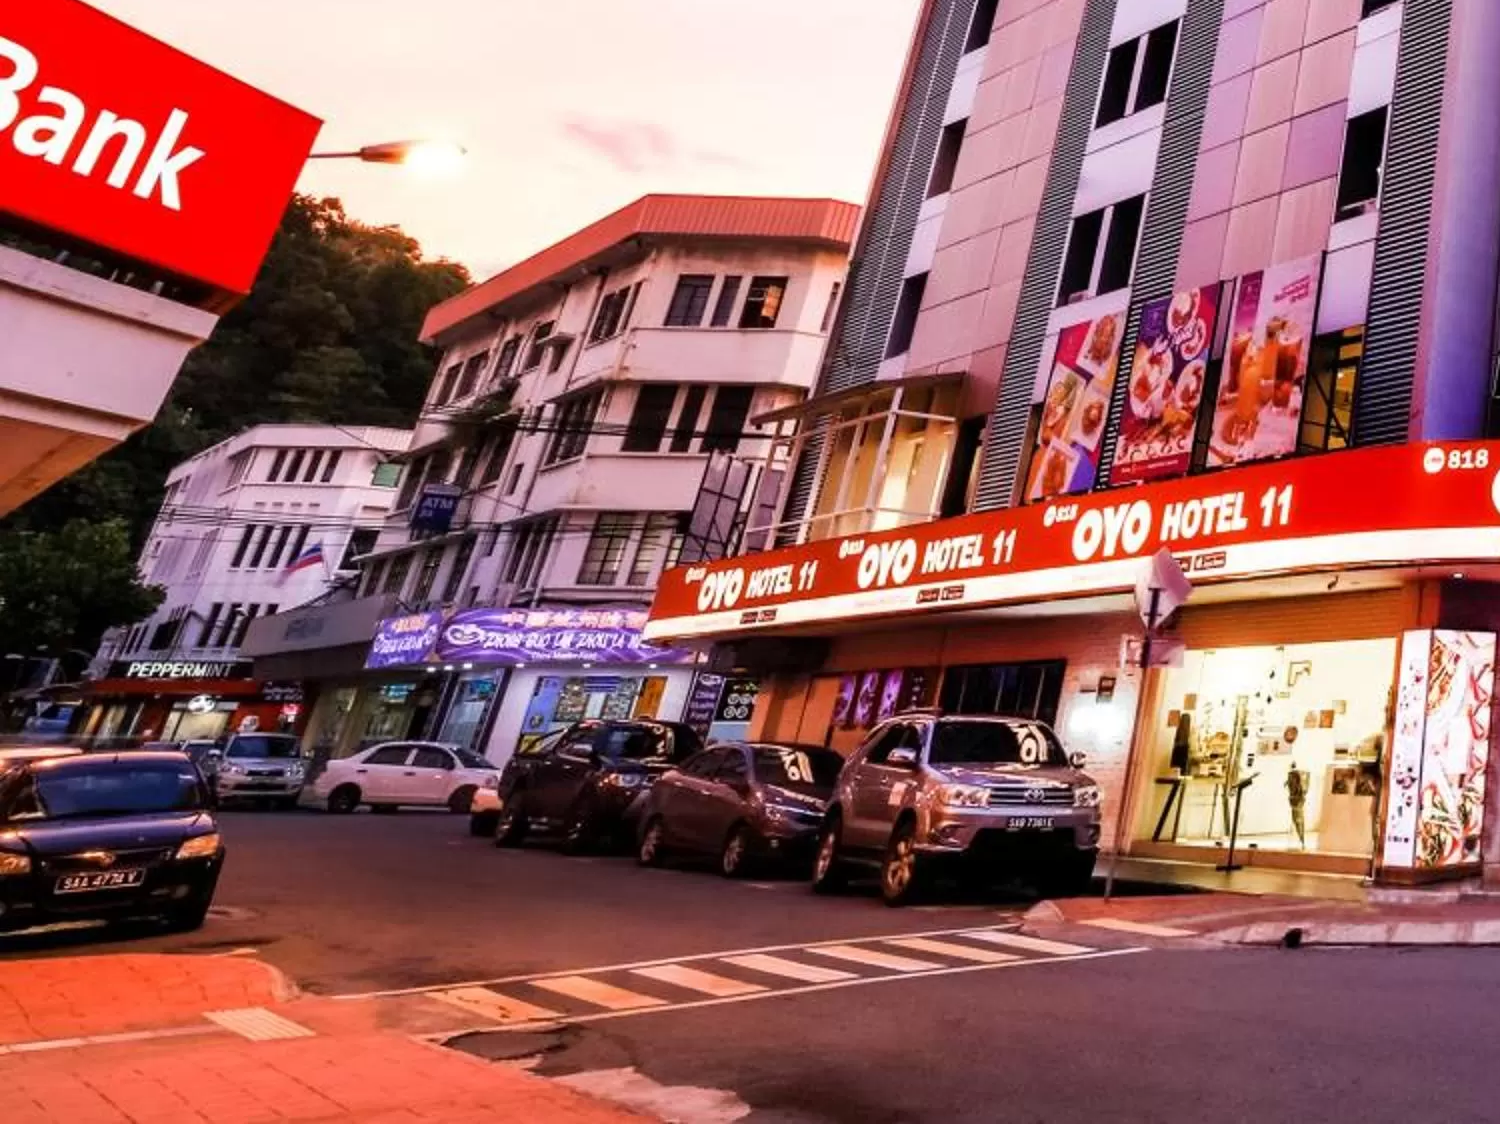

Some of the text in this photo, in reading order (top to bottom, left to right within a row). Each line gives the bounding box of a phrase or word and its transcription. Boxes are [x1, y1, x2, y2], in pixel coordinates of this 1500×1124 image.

[1447, 449, 1489, 470] 818
[1072, 484, 1293, 561] OYO HOTEL 11
[857, 528, 1017, 588] OYO HOTEL 11
[698, 559, 819, 612] OYO HOTEL 11
[127, 662, 236, 678] PEPPERMINT
